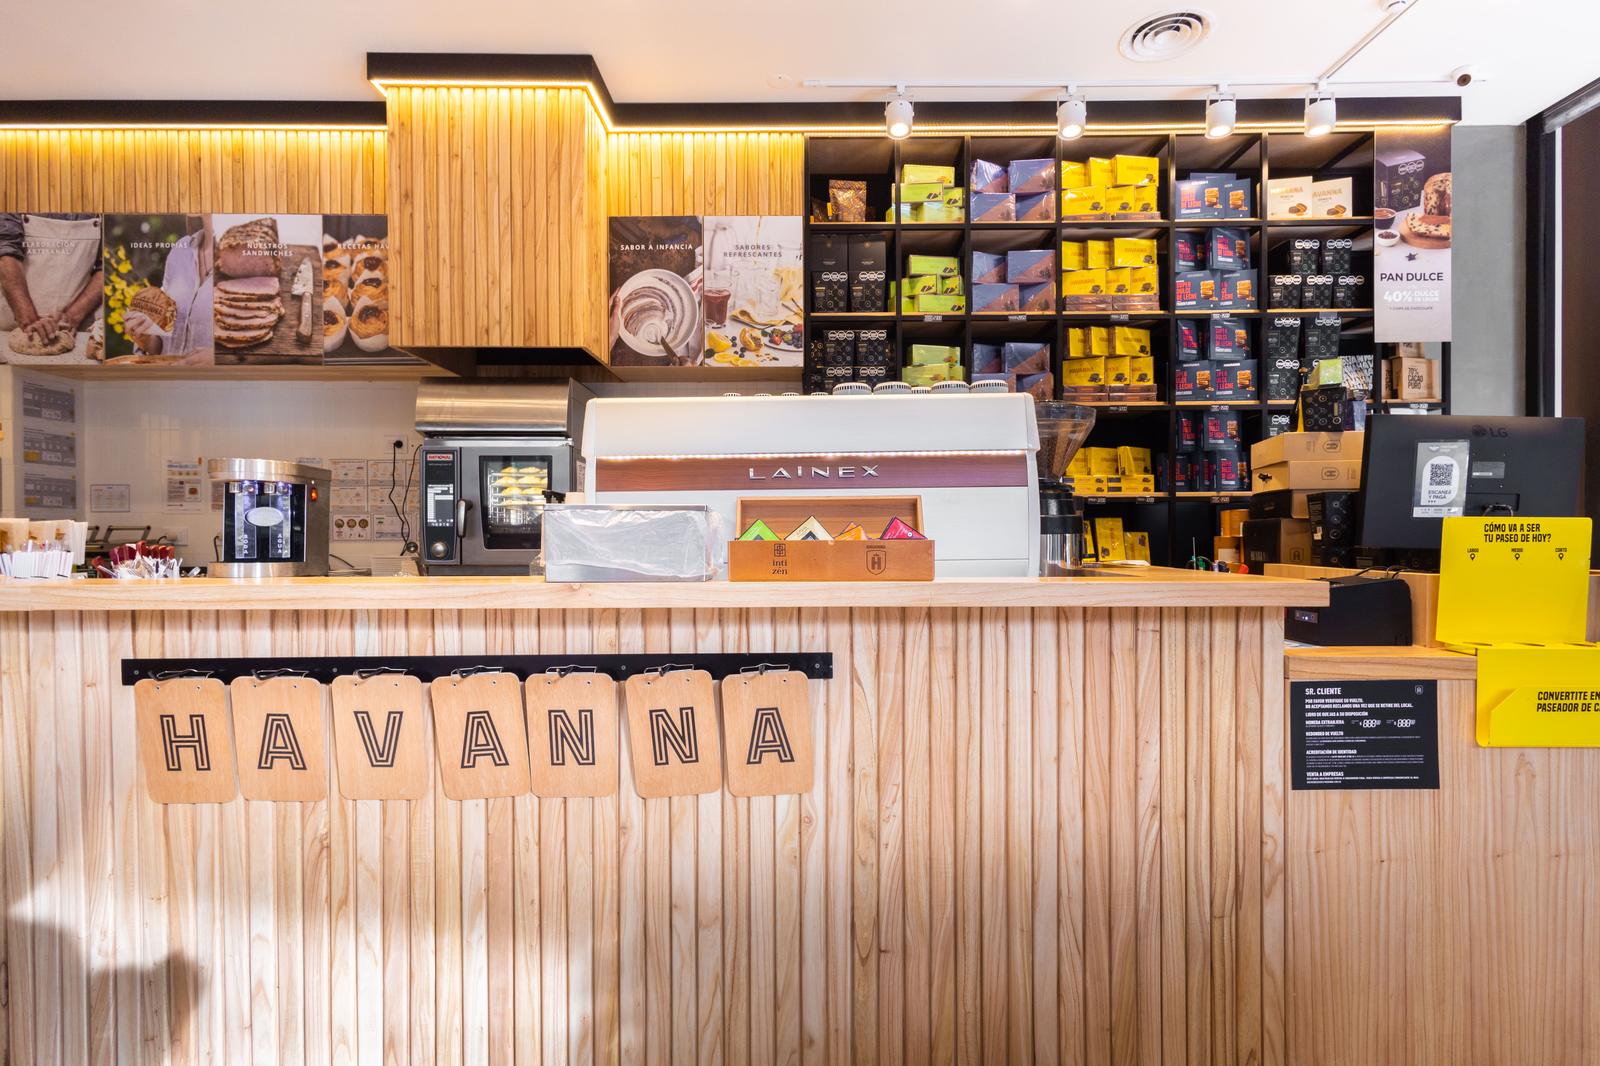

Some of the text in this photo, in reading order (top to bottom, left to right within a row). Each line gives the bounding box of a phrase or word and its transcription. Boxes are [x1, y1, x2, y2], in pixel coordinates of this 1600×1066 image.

[1380, 272, 1444, 281] PAN DULCE
[1384, 290, 1412, 302] 40%
[1489, 427, 1508, 438] LG
[749, 464, 880, 480] LAINEX
[1484, 522, 1541, 532] CÓMO VA A SER
[1484, 534, 1552, 542] TU PASEO DE HOY?
[1537, 691, 1588, 700] CONVERTITE
[1537, 703, 1600, 712] PASEADOR DE C
